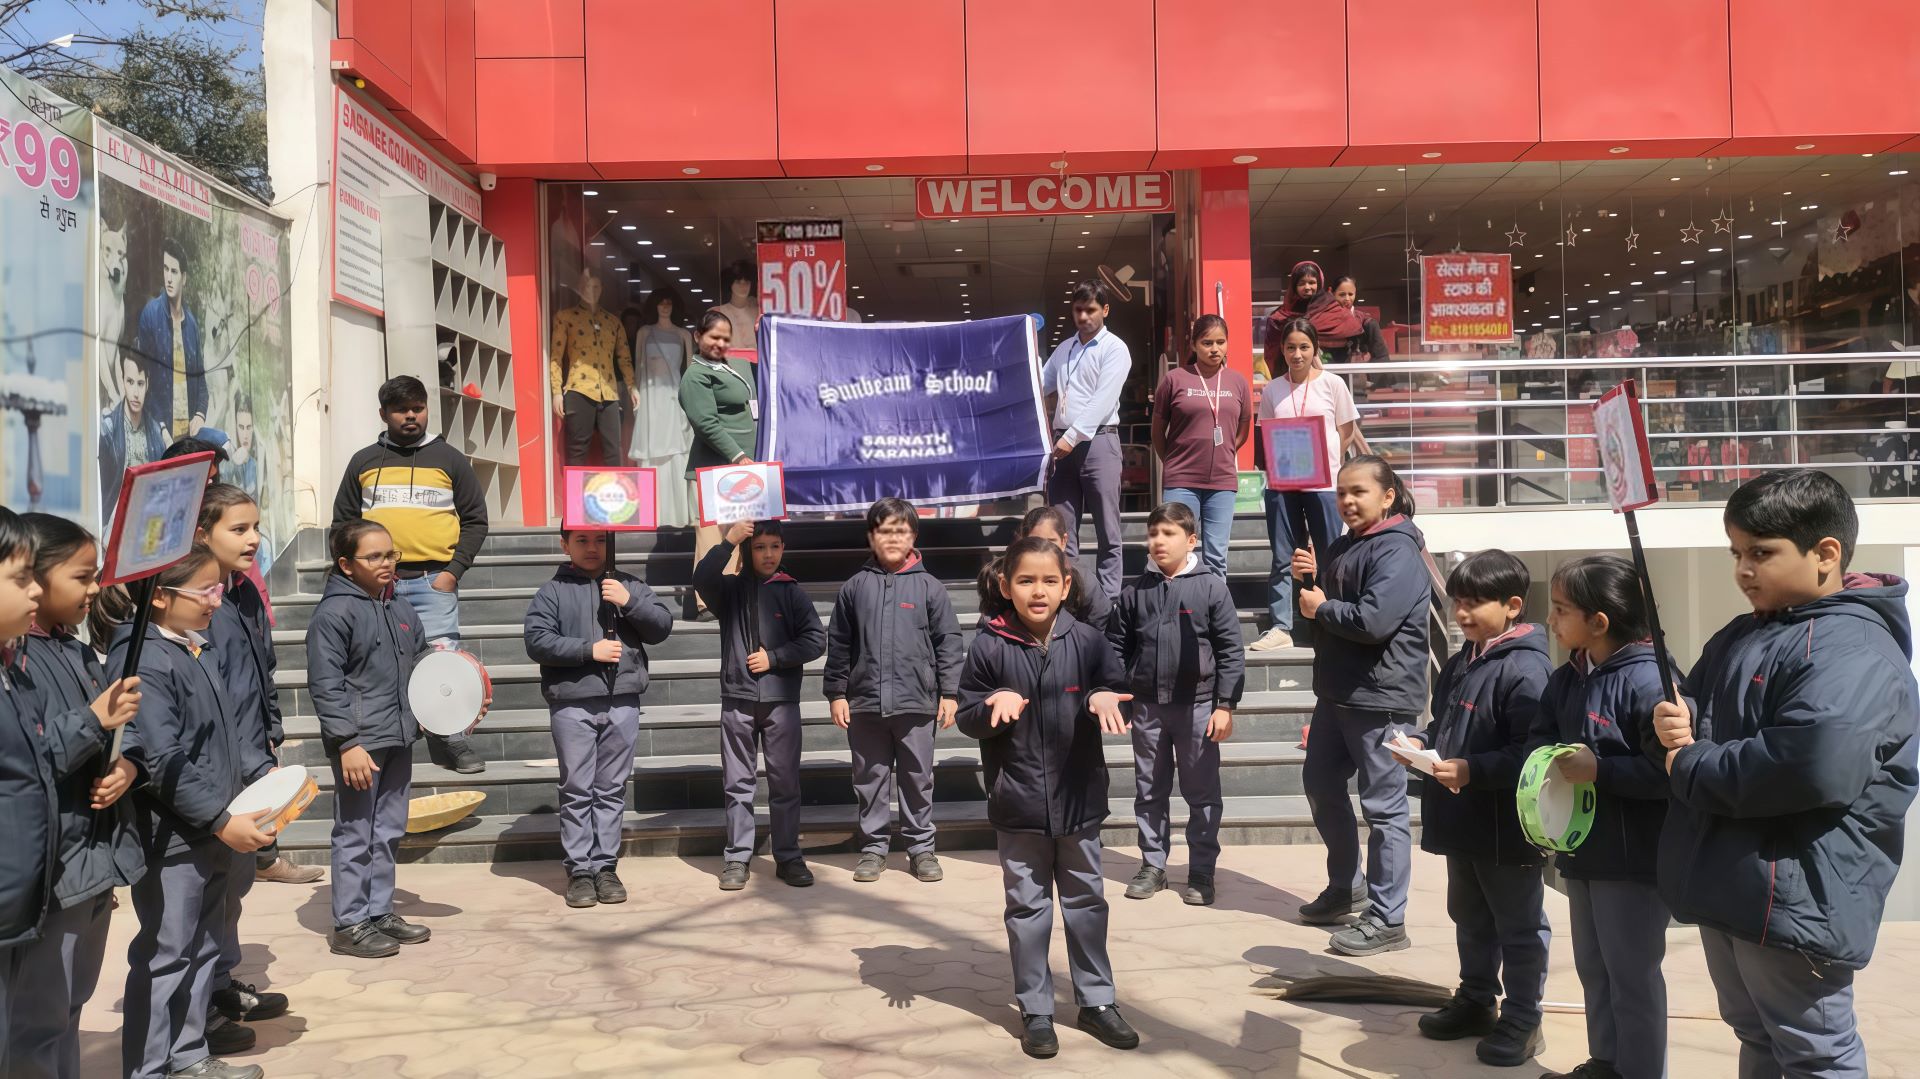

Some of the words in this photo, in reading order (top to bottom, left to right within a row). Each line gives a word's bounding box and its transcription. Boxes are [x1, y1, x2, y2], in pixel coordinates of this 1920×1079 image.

[926, 174, 1163, 214] WELCOME
[805, 222, 840, 238] BAZAR
[761, 260, 842, 320] 50%
[817, 373, 913, 408] Sunbeam
[924, 368, 994, 396] School
[860, 444, 954, 460] VARANASI
[861, 432, 948, 447] SARNATH
